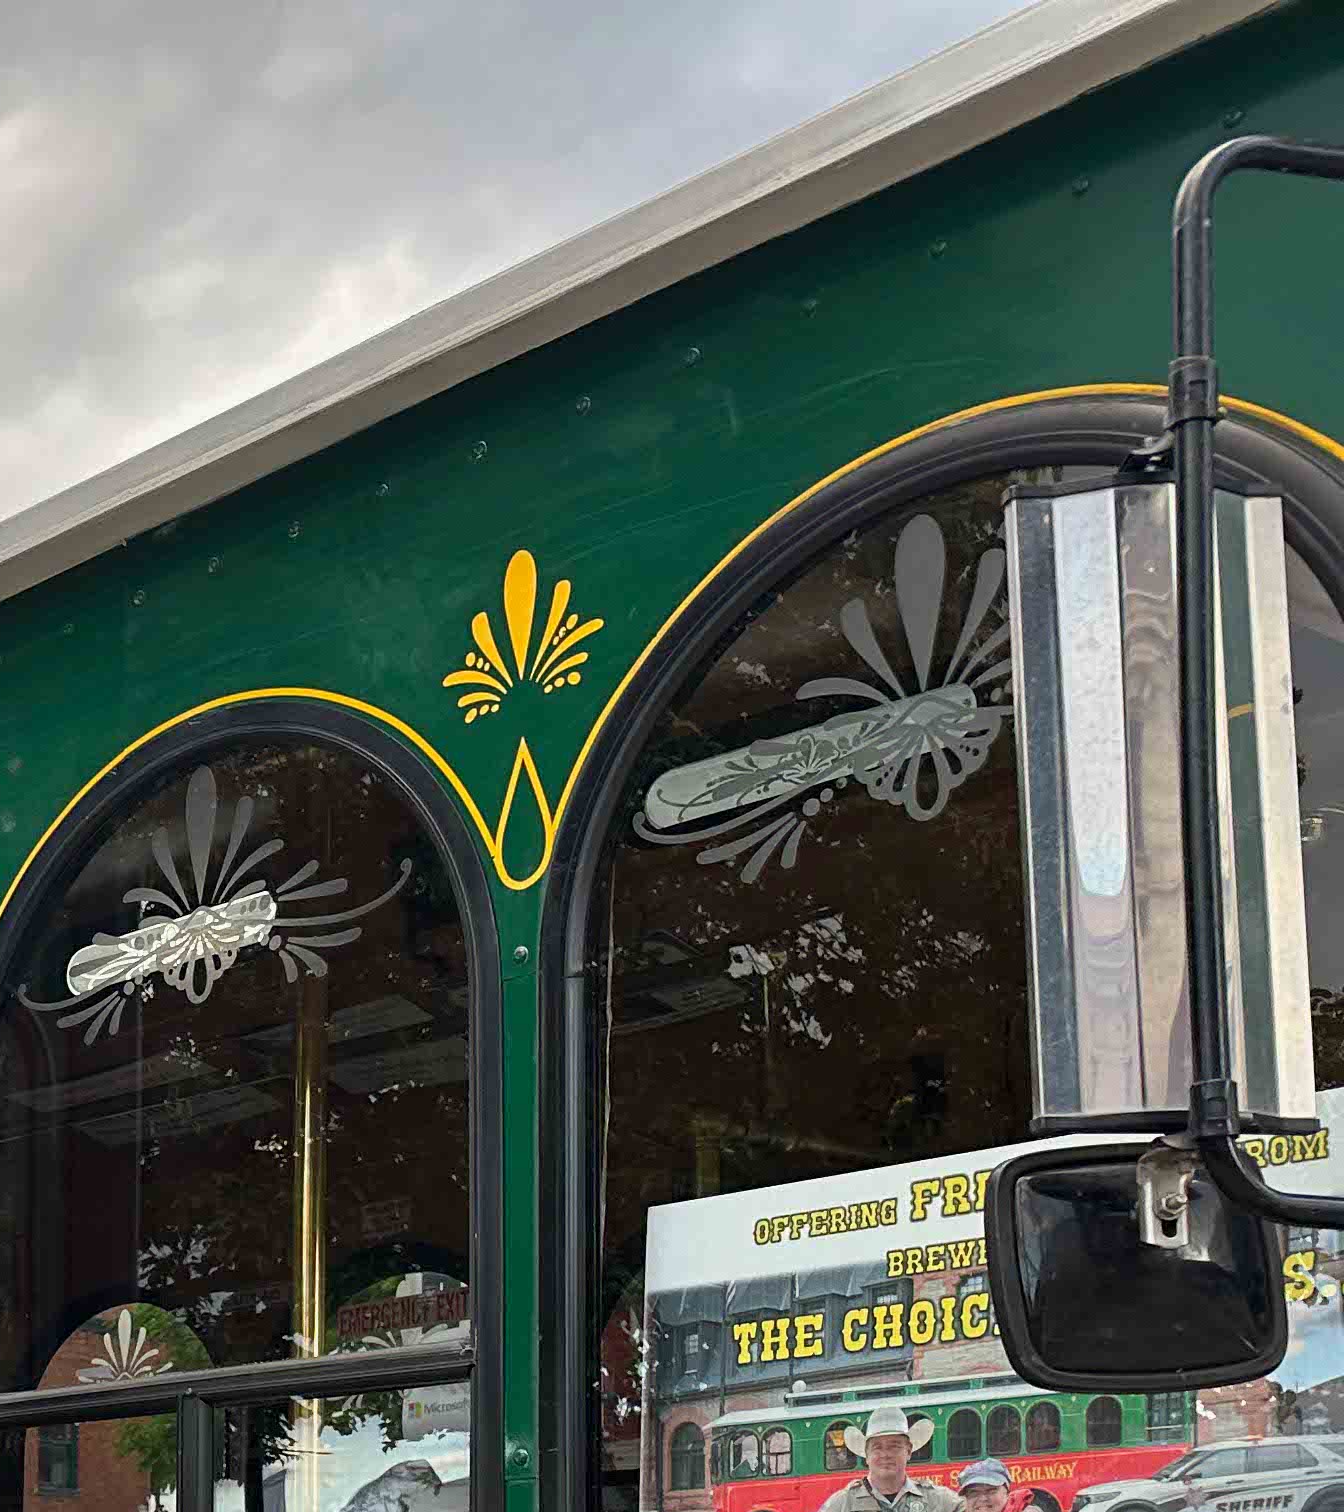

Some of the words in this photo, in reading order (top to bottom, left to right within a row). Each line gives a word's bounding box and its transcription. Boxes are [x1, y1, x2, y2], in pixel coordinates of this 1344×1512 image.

[752, 1197, 898, 1245] OFFERING
[1237, 1127, 1330, 1168] ROM
[732, 1312, 825, 1366] THE
[840, 1291, 1002, 1353] CHOIC
[1010, 1460, 1080, 1485] RAILWAY
